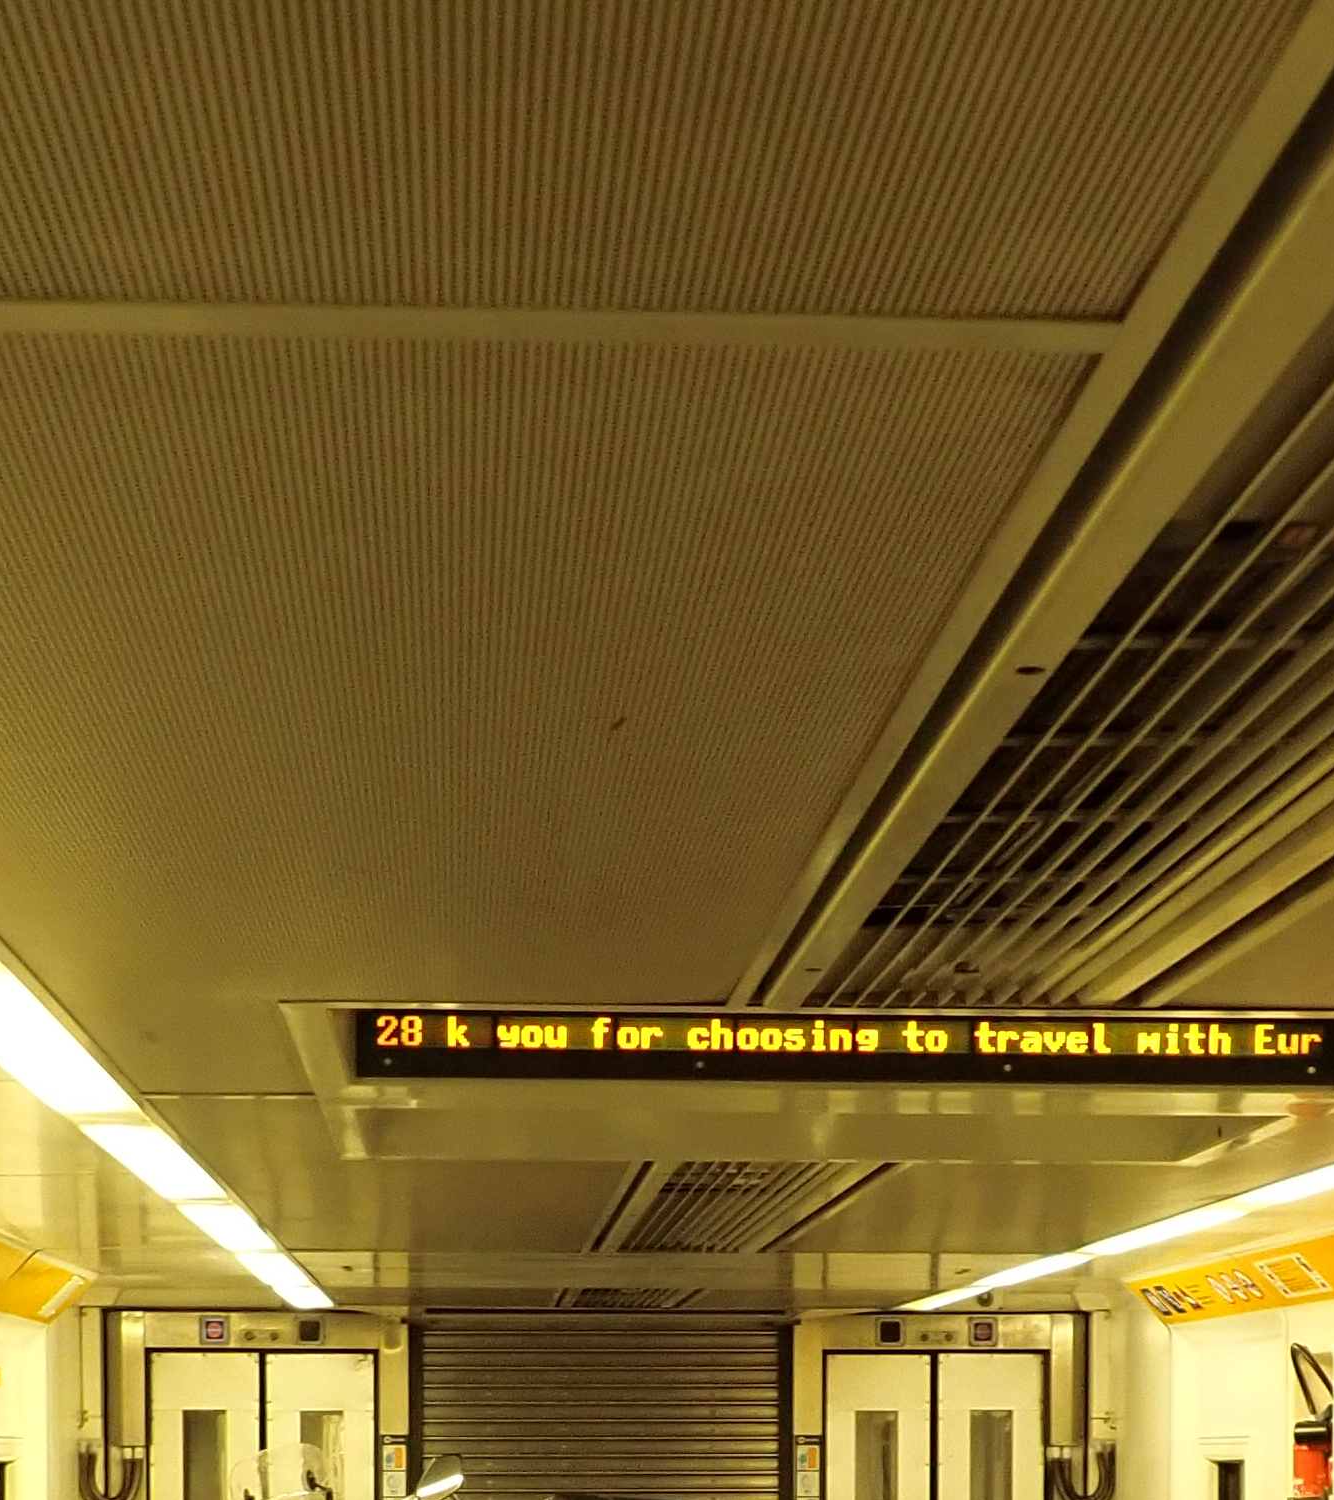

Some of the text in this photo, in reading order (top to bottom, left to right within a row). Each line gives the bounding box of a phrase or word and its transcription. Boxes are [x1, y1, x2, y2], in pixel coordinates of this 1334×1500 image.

[375, 1015, 1322, 1055] 28 k you for choosing to travel with Eur
